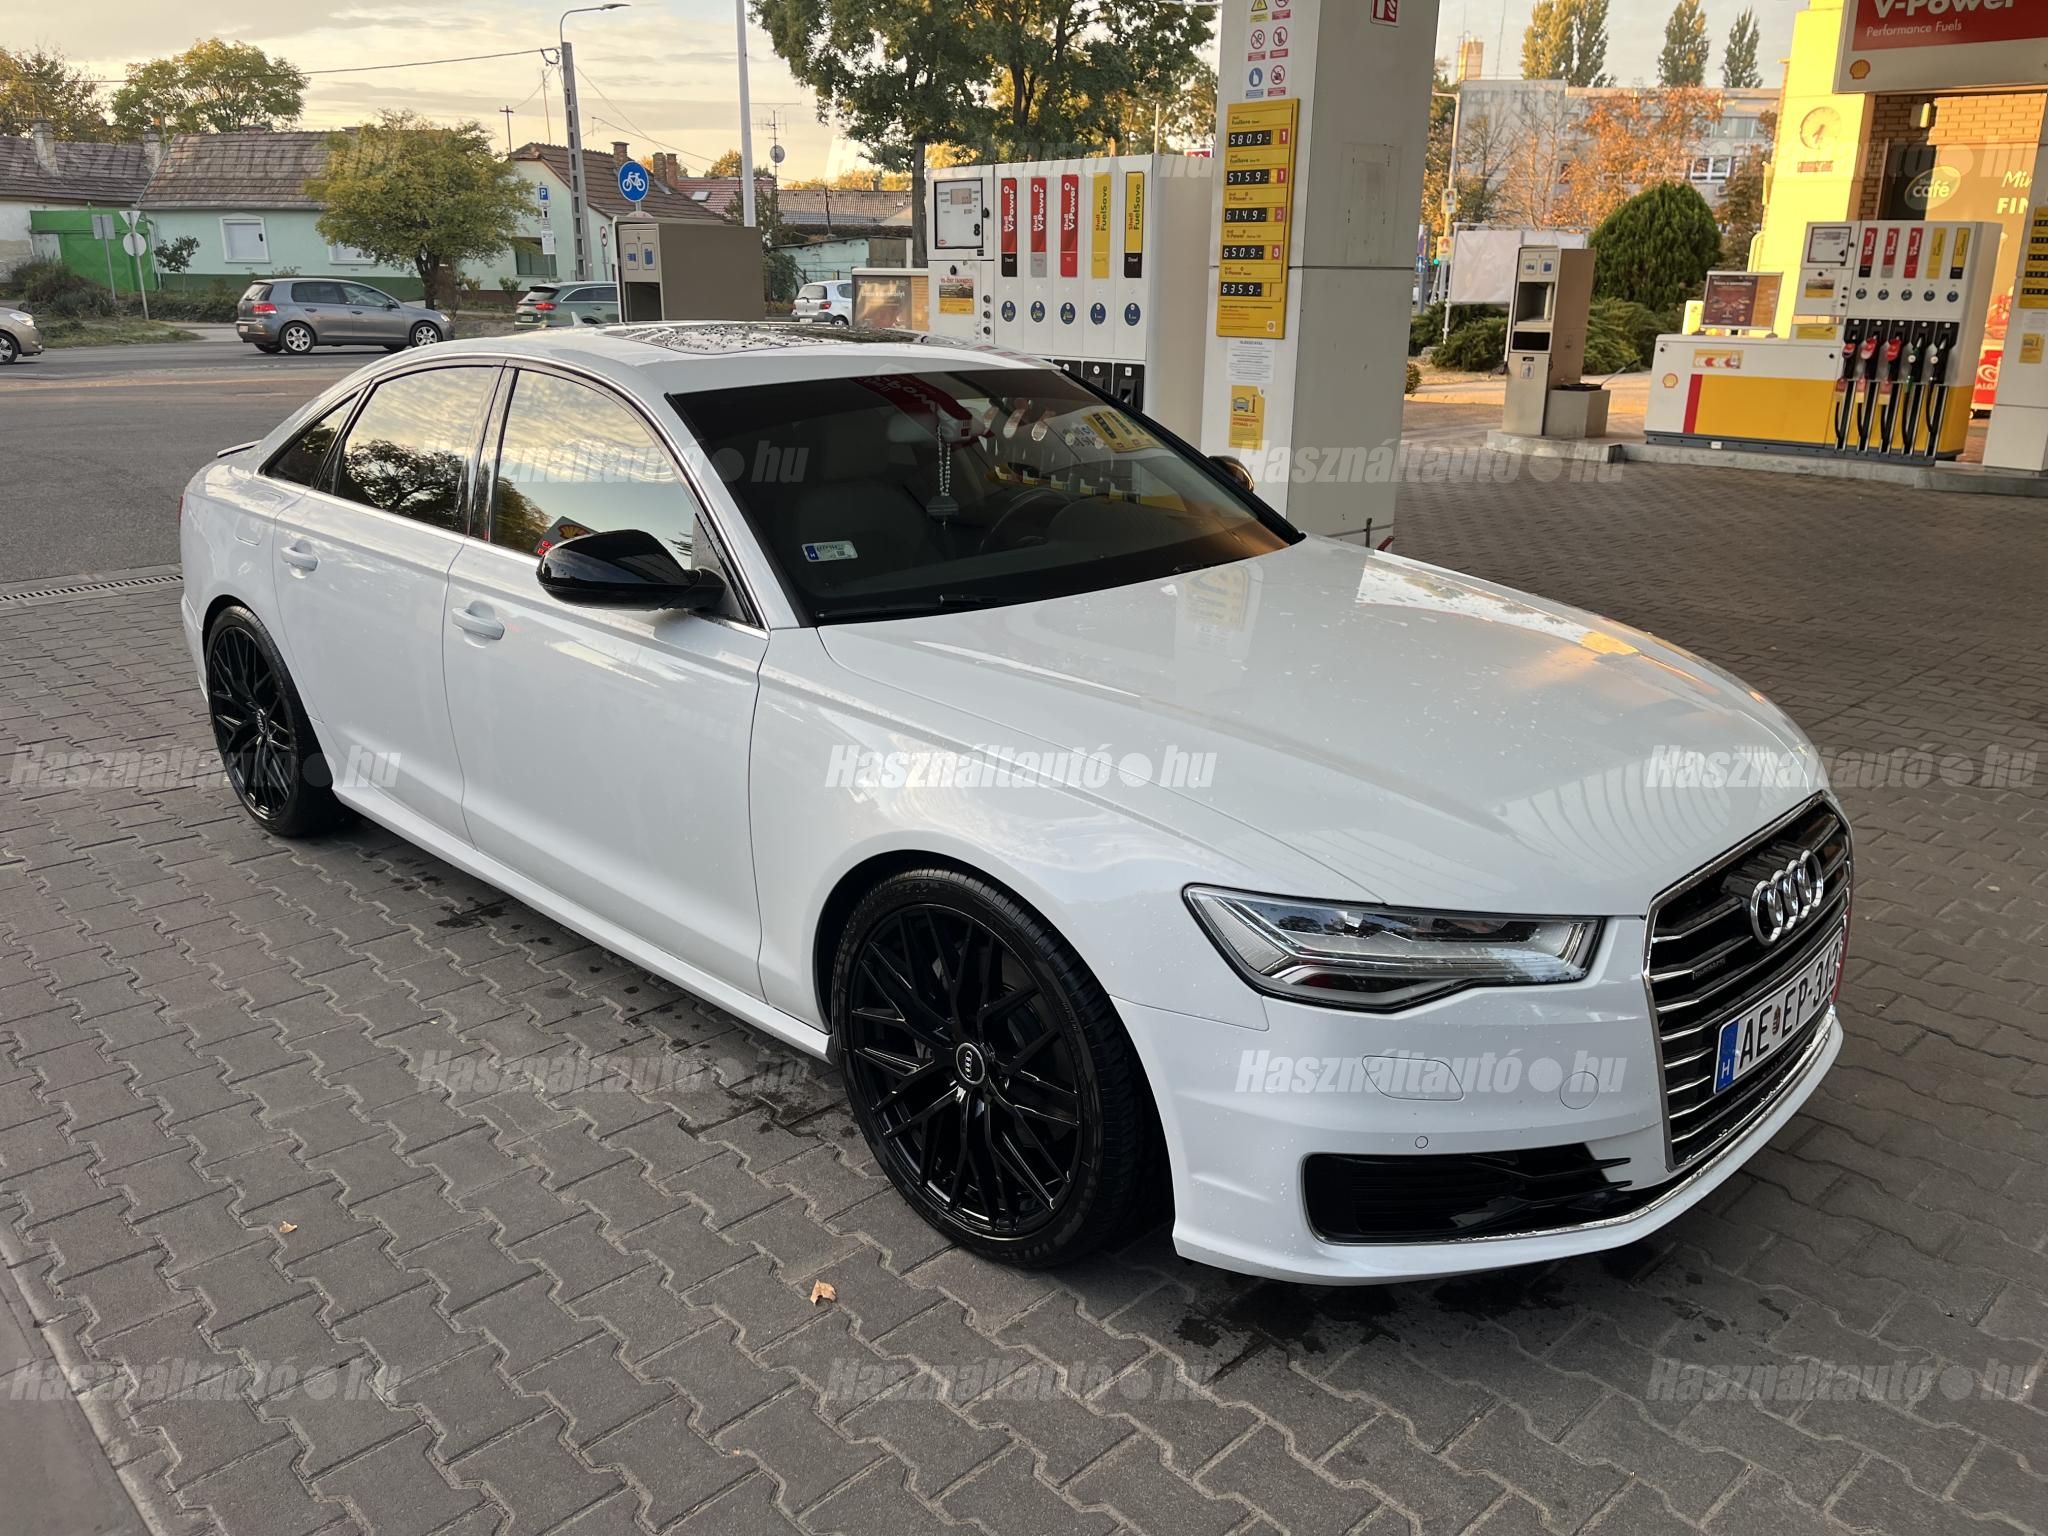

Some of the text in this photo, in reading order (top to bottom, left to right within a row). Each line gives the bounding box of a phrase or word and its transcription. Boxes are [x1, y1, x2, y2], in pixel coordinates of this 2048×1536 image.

[1874, 0, 2015, 19] V-Power
[1866, 19, 1962, 38] Performance Fuels
[1912, 180, 1950, 198] café
[1068, 186, 1076, 230] V-Power
[1100, 186, 1108, 231] FuelSave
[1133, 184, 1141, 230] FuelSave
[973, 223, 981, 236] 8
[1721, 1059, 1731, 1079] H
